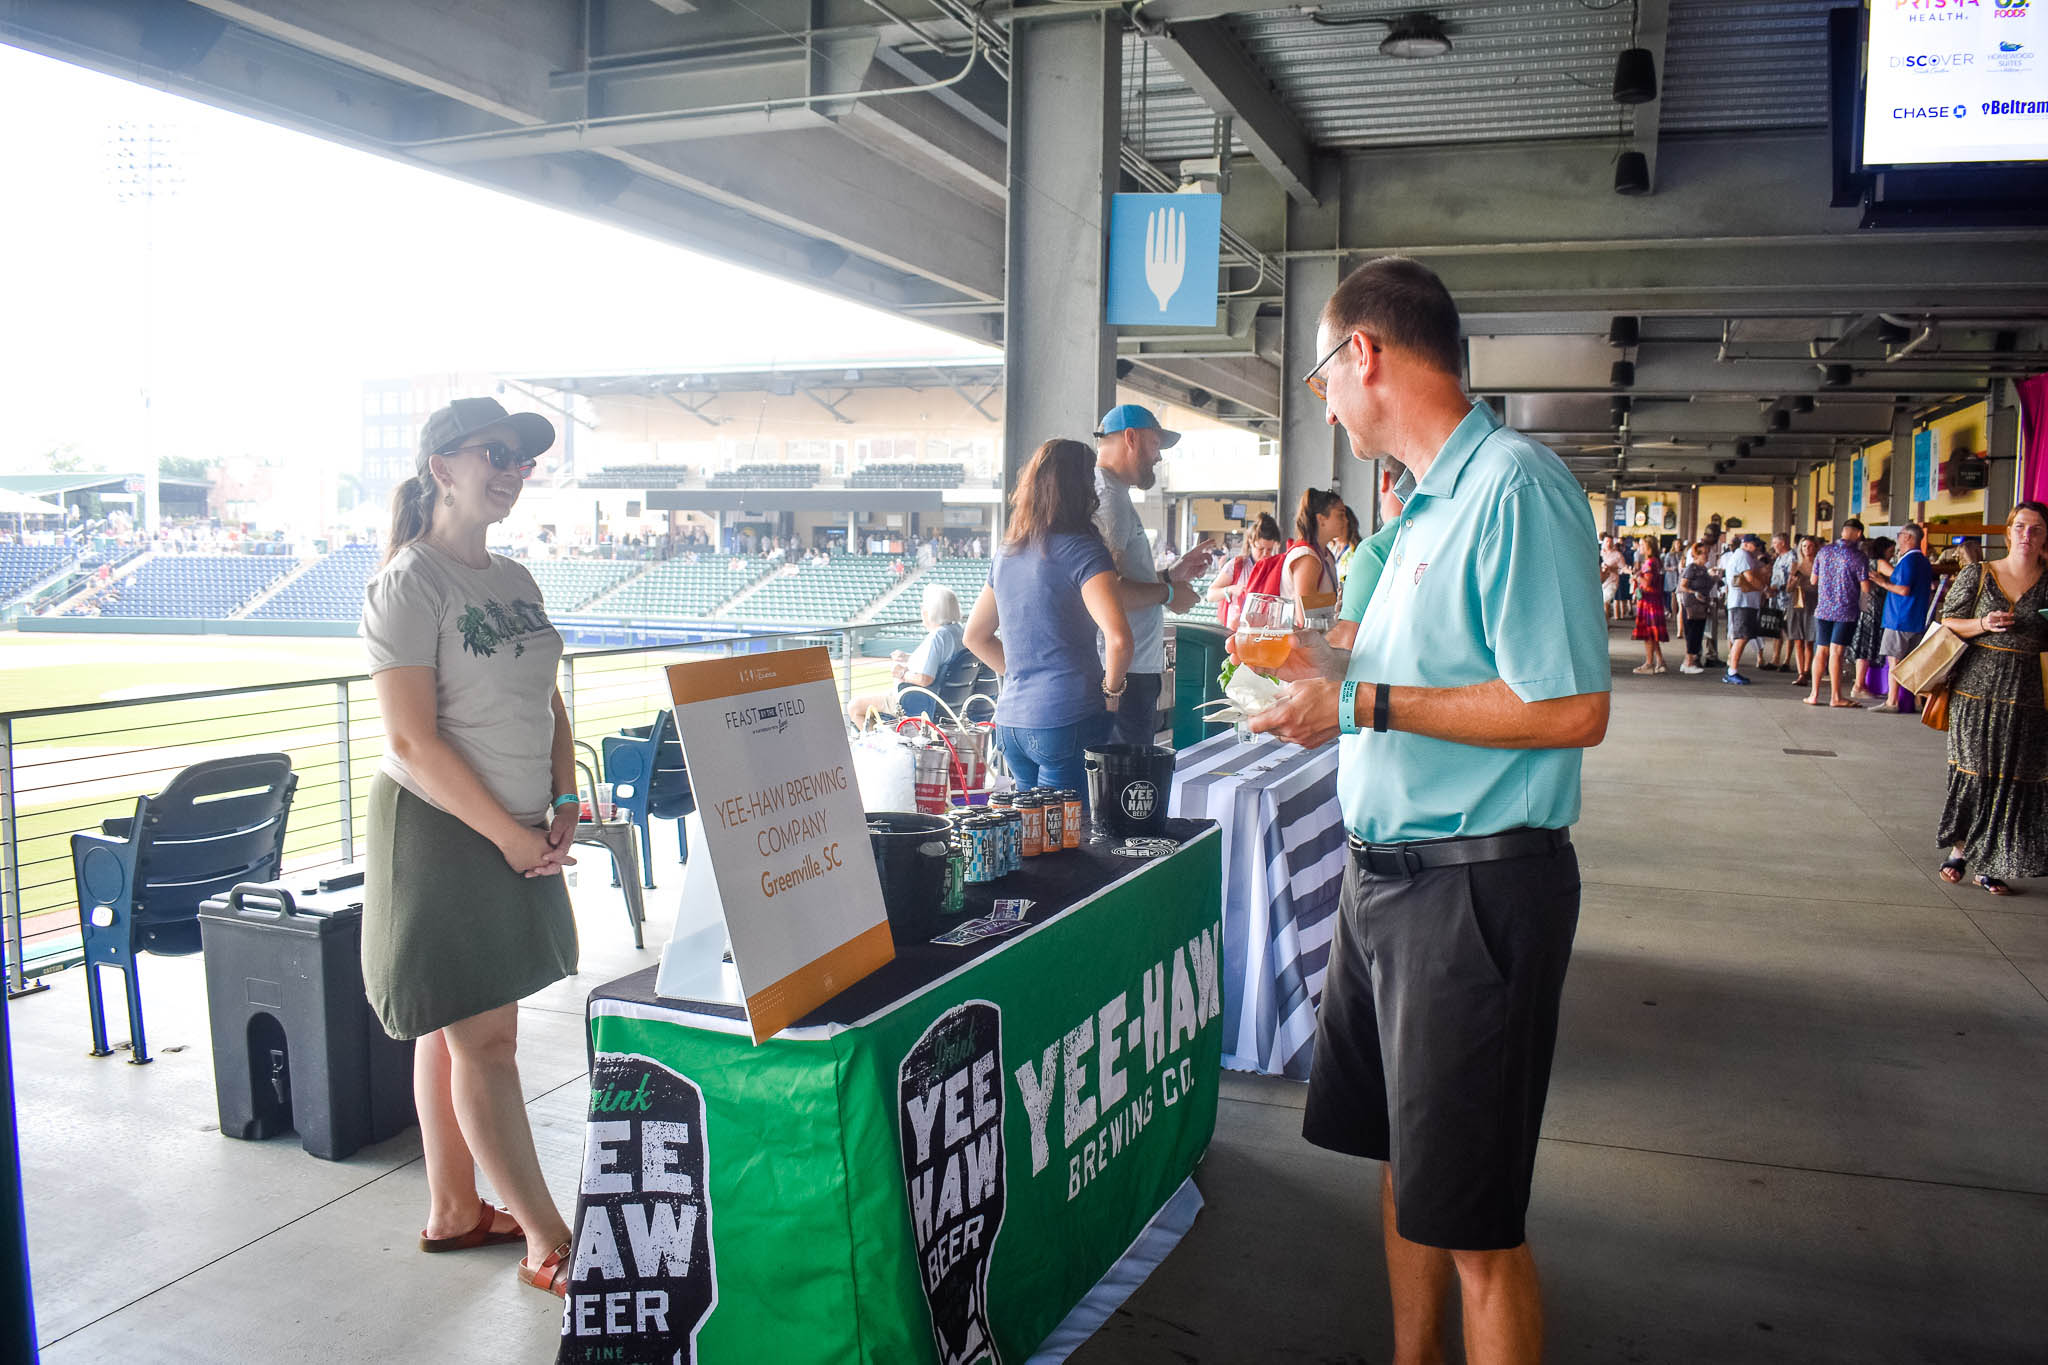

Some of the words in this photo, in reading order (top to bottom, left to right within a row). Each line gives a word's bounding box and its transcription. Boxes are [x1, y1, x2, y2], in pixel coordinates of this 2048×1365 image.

[1994, 8, 2026, 19] FOODS
[1889, 53, 1975, 68] DISCOVER
[1893, 106, 1950, 119] CHASE
[725, 707, 758, 729] FEAST
[777, 698, 806, 718] FIELD
[714, 784, 785, 830] YEE-HAW
[786, 766, 848, 807] BREWING
[1128, 789, 1154, 800] YEE
[1128, 800, 1153, 811] HAW
[757, 808, 828, 857] COMPANY
[761, 853, 825, 898] Greenville,
[823, 842, 843, 871] SC
[1015, 920, 1220, 1178] YEE-HAW
[906, 1050, 998, 1166] YEE
[1067, 1085, 1153, 1202] BREWING
[1162, 1057, 1195, 1107] CO.
[911, 1124, 998, 1253] HAW
[927, 1214, 985, 1295] BEER
[585, 1346, 625, 1361] FINE
